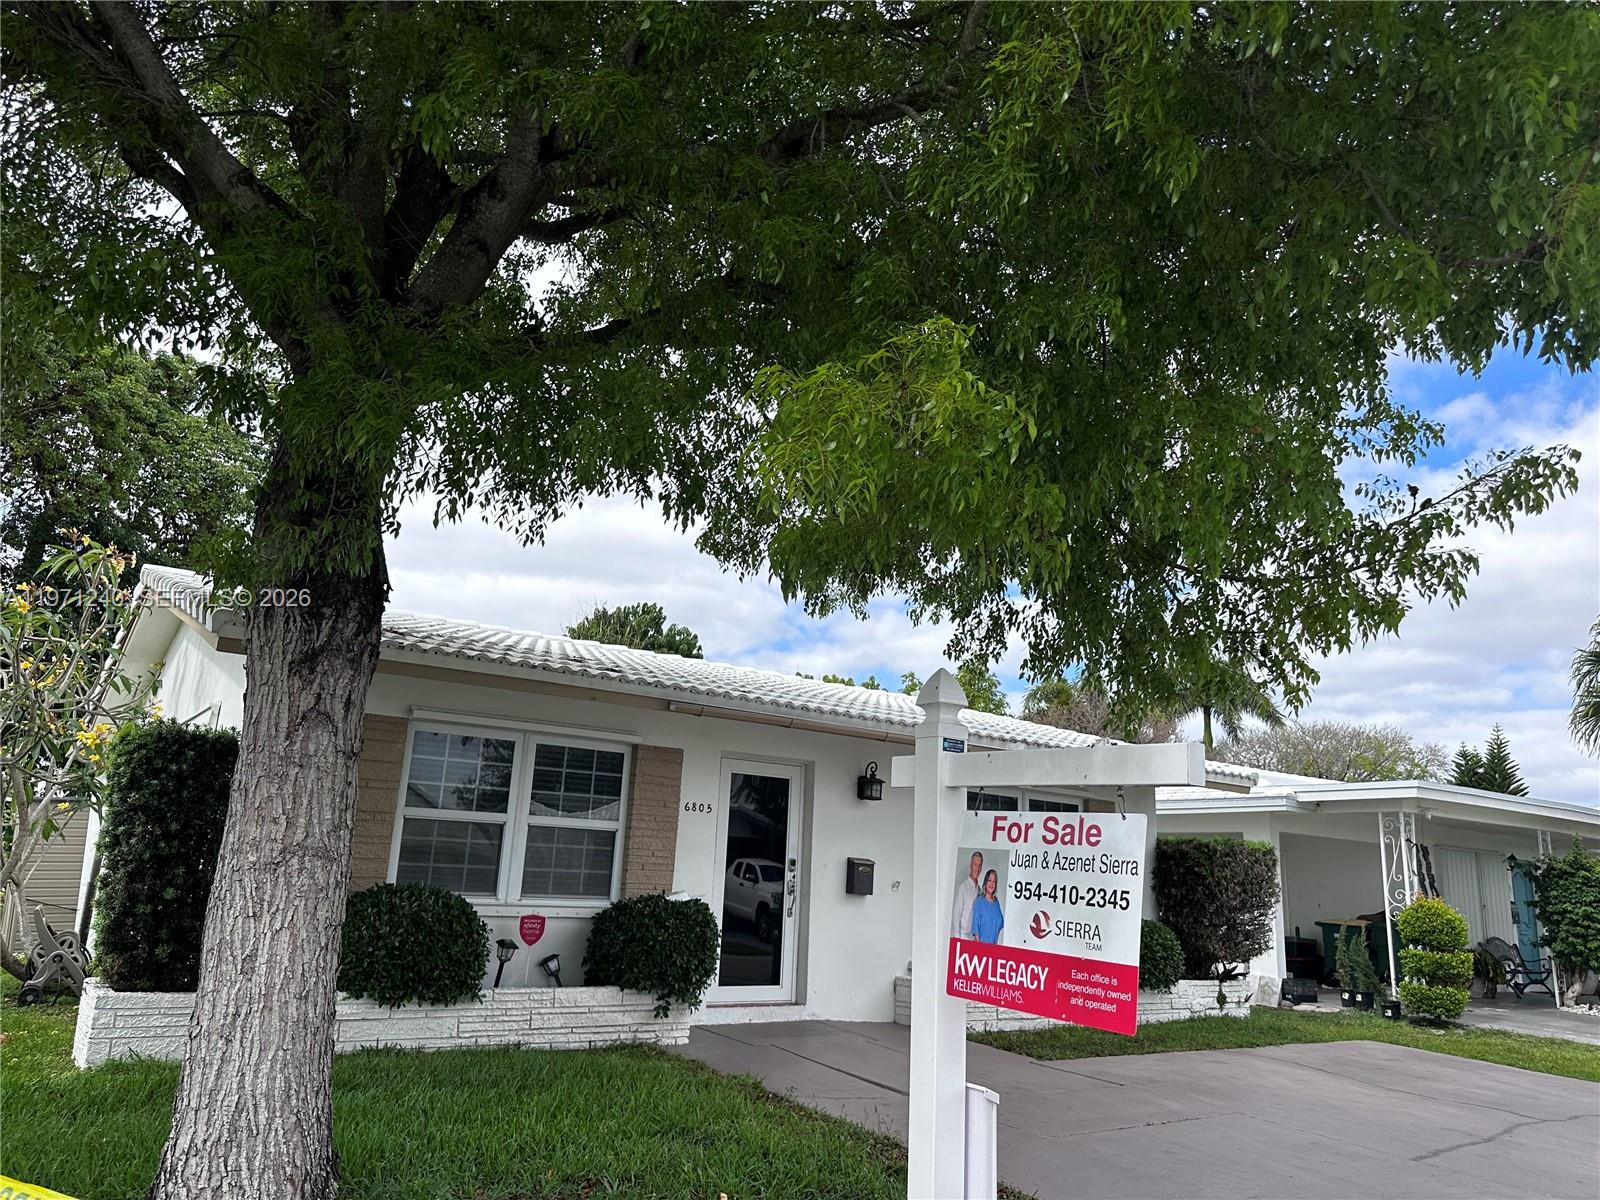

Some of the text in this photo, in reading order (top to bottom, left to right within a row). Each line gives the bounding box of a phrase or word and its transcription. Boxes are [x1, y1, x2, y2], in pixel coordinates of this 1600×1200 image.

[684, 801, 713, 814] 6805
[991, 815, 1102, 847] For Sale
[1010, 849, 1139, 876] Juan & Azenet Sierra
[1013, 880, 1130, 911] 954-410-2345
[1054, 919, 1102, 941] SIERRA
[1085, 942, 1102, 952] TEAM
[987, 957, 1049, 991] LEGACY
[1071, 969, 1118, 986] Each office is
[1058, 981, 1132, 1001] independently owned
[1070, 995, 1117, 1013] and operated
